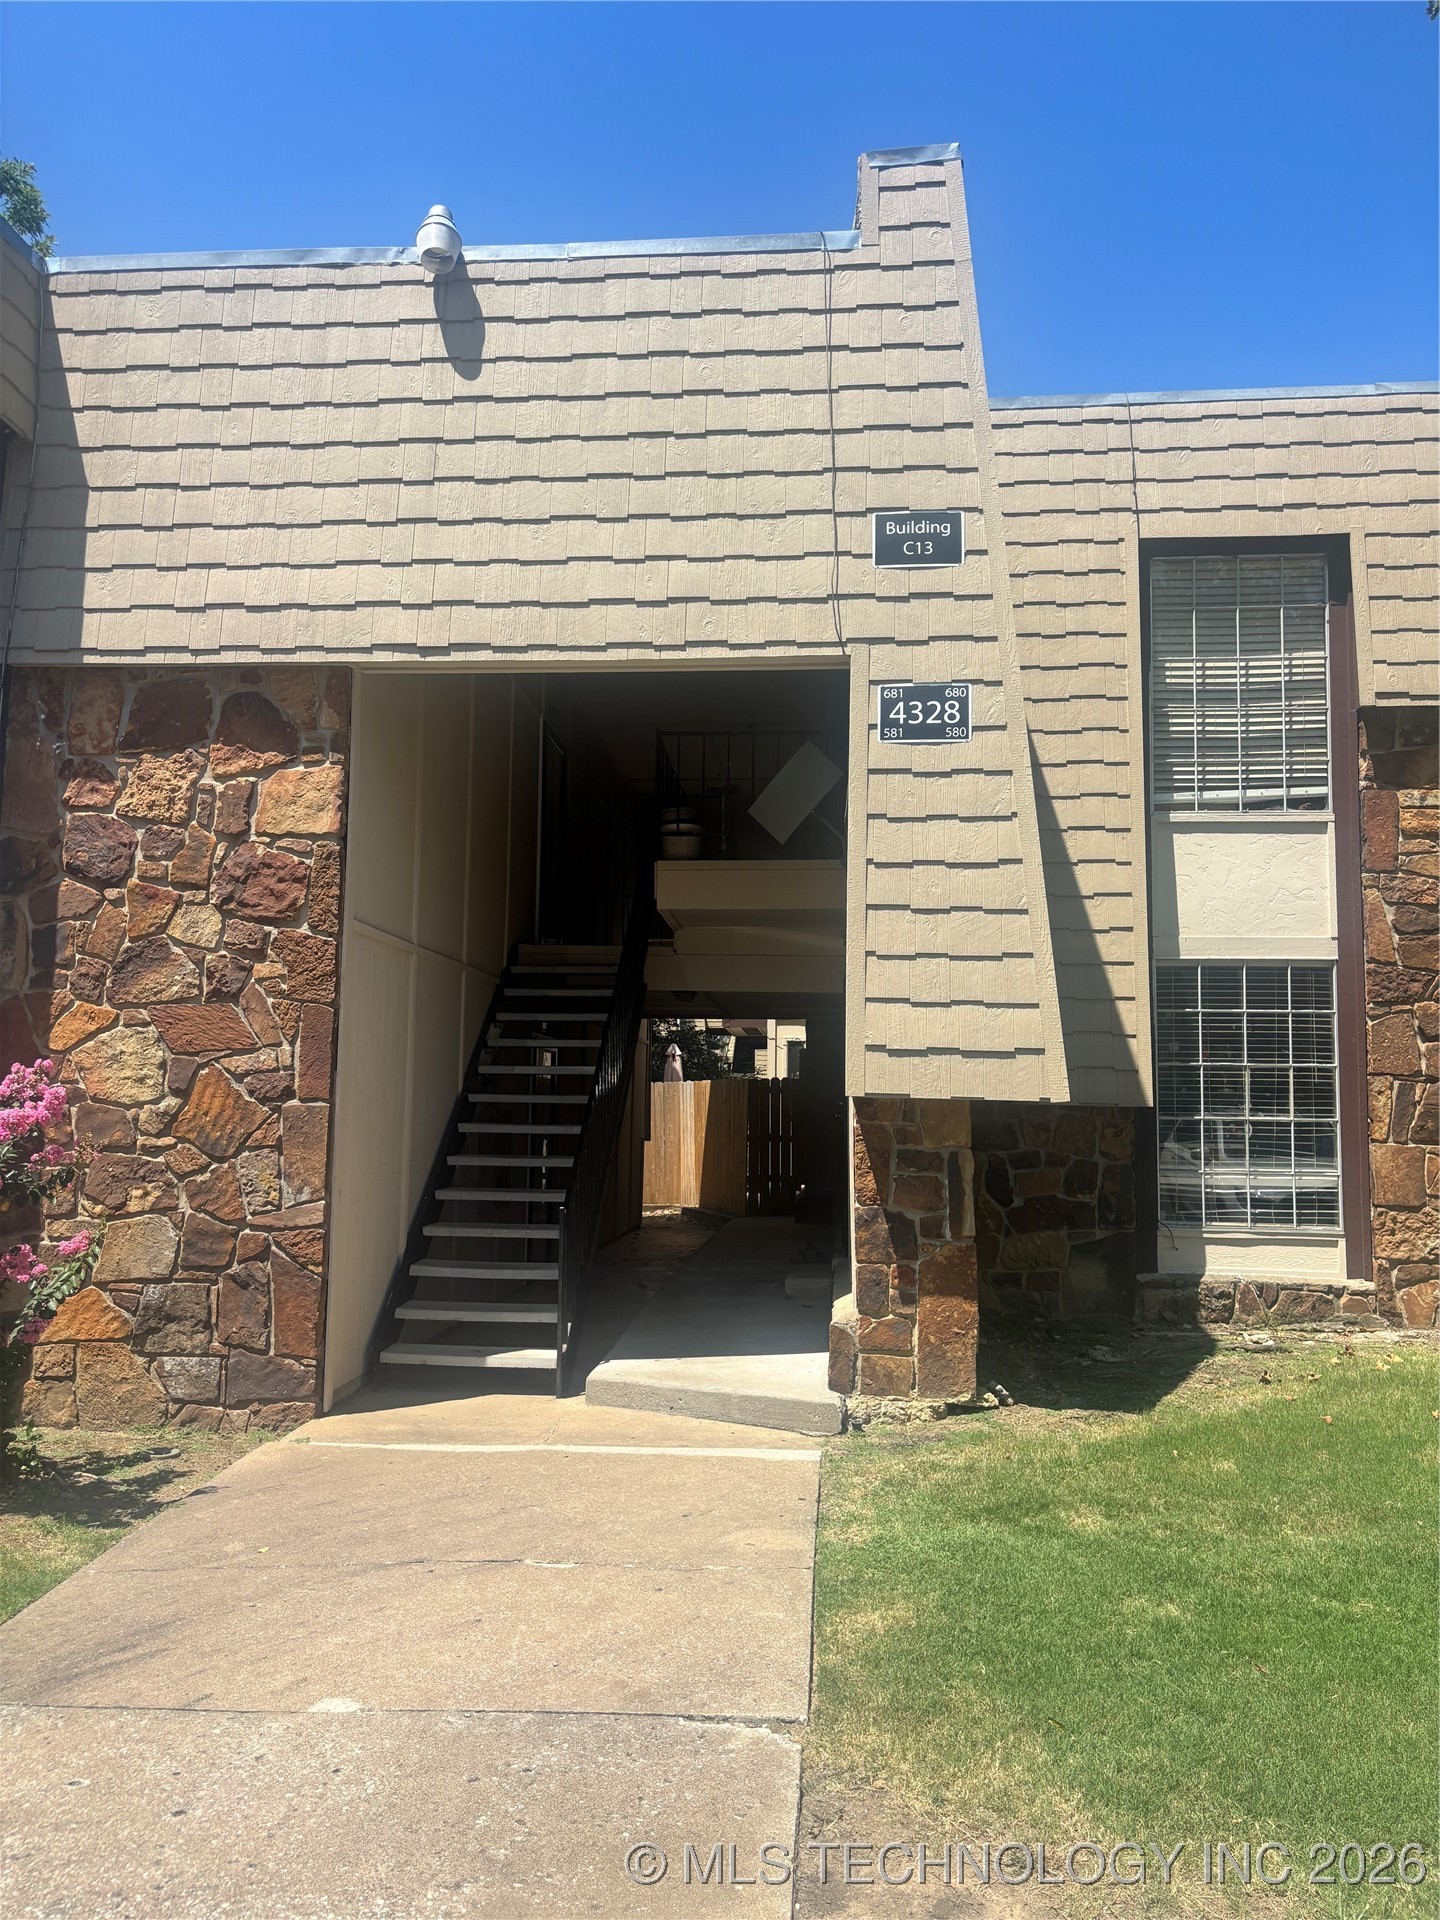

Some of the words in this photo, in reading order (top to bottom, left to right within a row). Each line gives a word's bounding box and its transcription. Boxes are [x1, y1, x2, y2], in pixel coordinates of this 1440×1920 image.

[886, 520, 951, 537] Building
[903, 541, 933, 555] C13
[883, 688, 903, 699] 681
[945, 687, 967, 698] 680
[889, 700, 960, 724] 4328
[883, 728, 903, 738] 581
[945, 727, 967, 738] 580
